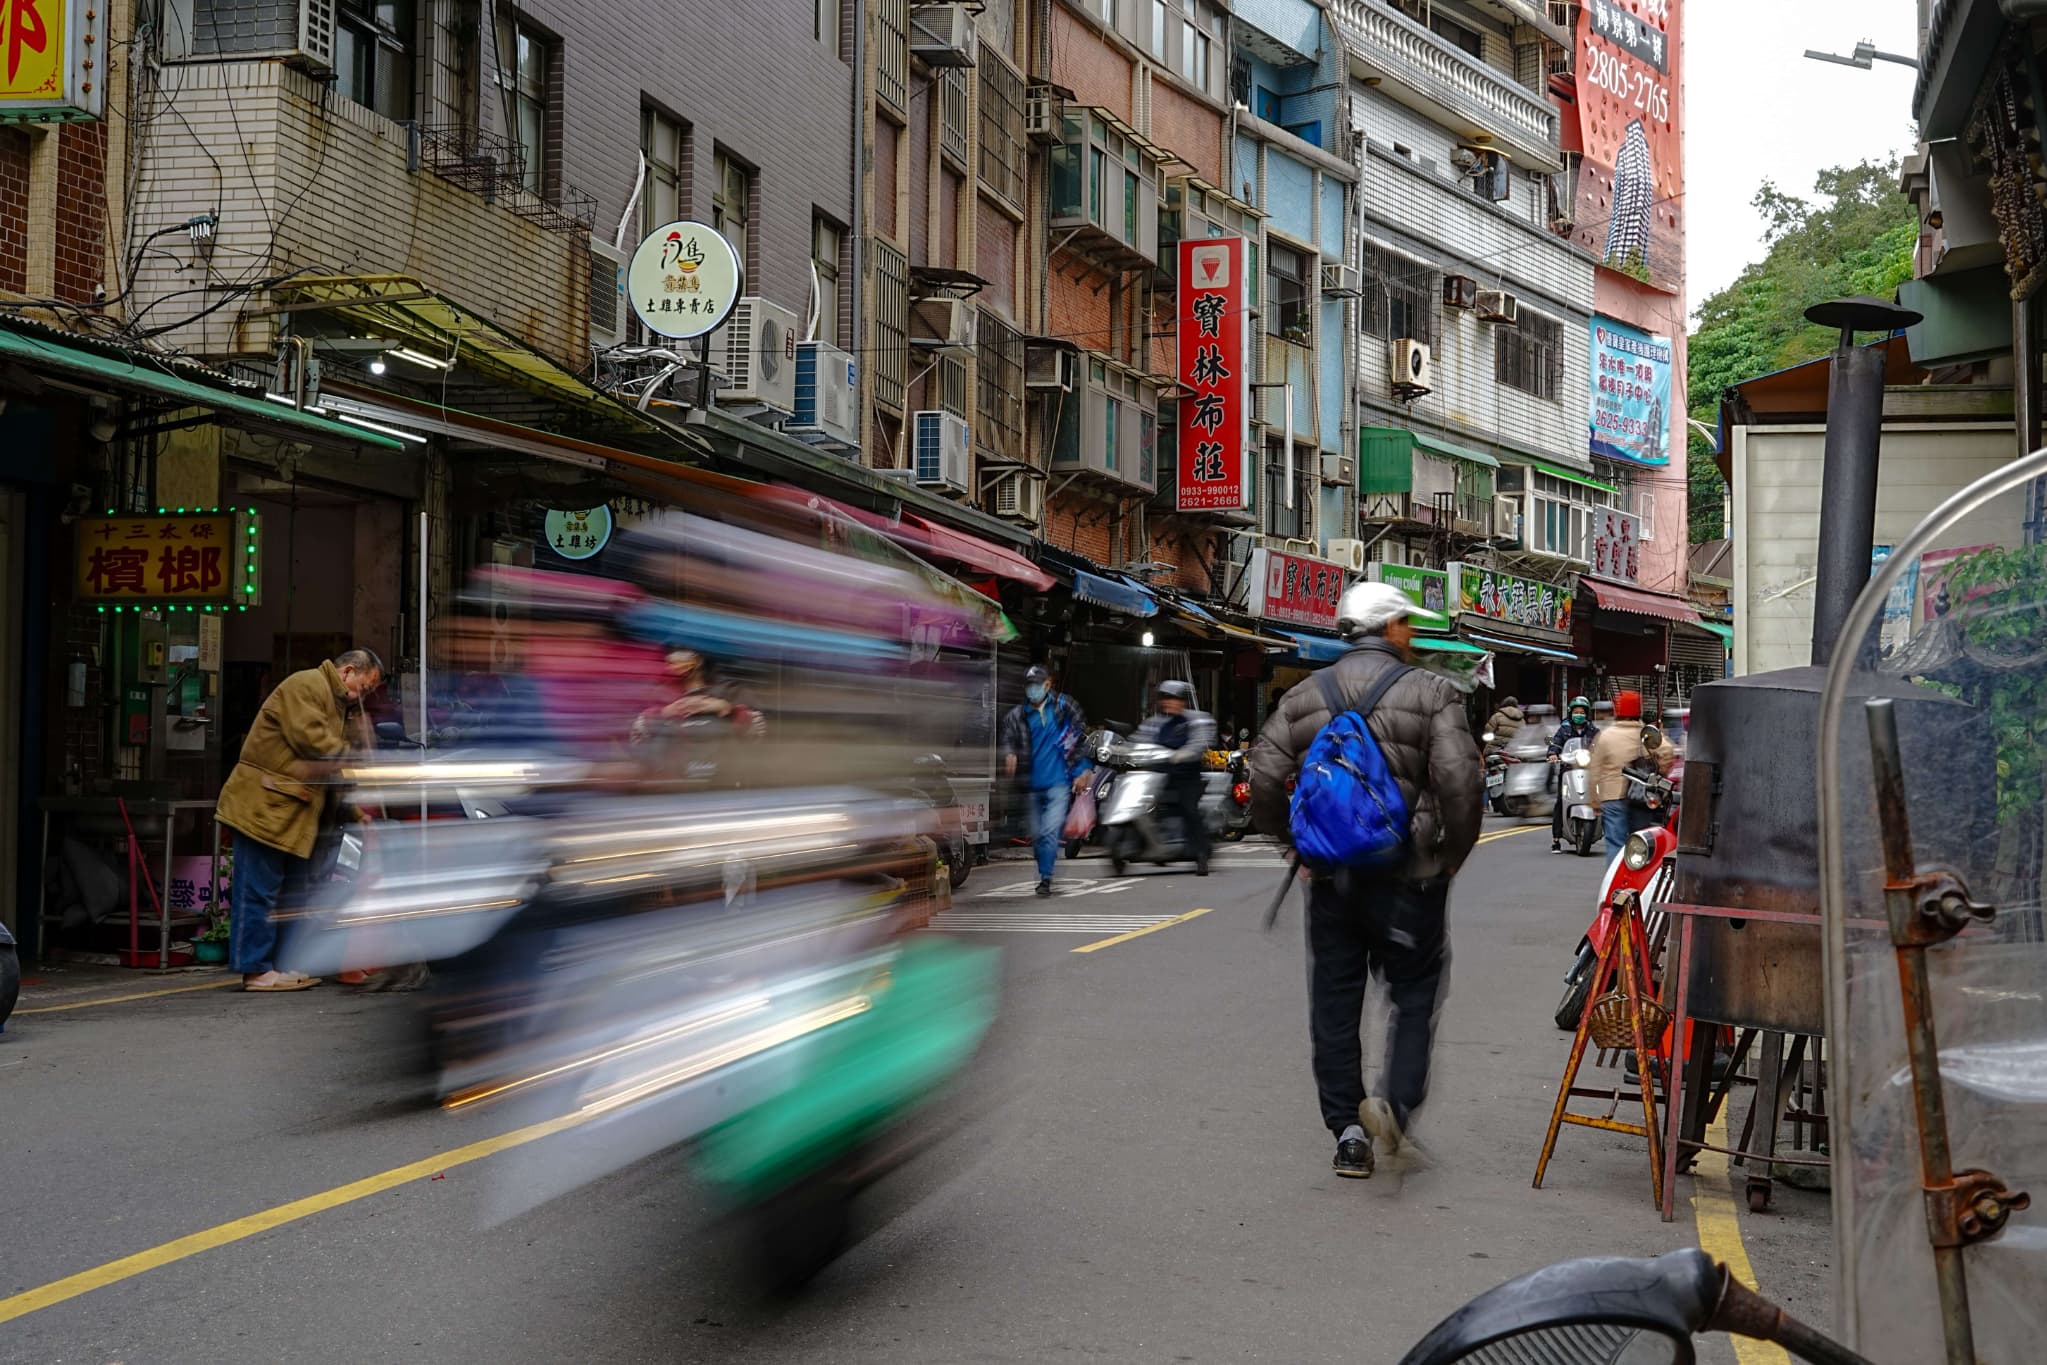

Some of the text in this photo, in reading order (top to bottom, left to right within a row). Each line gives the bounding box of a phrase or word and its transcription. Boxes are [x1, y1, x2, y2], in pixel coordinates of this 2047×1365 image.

[1587, 45, 1669, 123] 2805-2765
[645, 298, 715, 315] 土雞專賣店
[1190, 291, 1231, 483] 寶林布莊
[1595, 409, 1648, 438] 2625-9333
[1181, 485, 1239, 496] 0933-990012
[1181, 496, 1239, 507] 2621-2666
[94, 522, 216, 541] 十三太保
[555, 533, 598, 550] 土雞坊
[86, 545, 222, 594] 檳榔
[1287, 559, 1340, 607] 寶林布莊
[1480, 572, 1554, 626] 永大蔬果行
